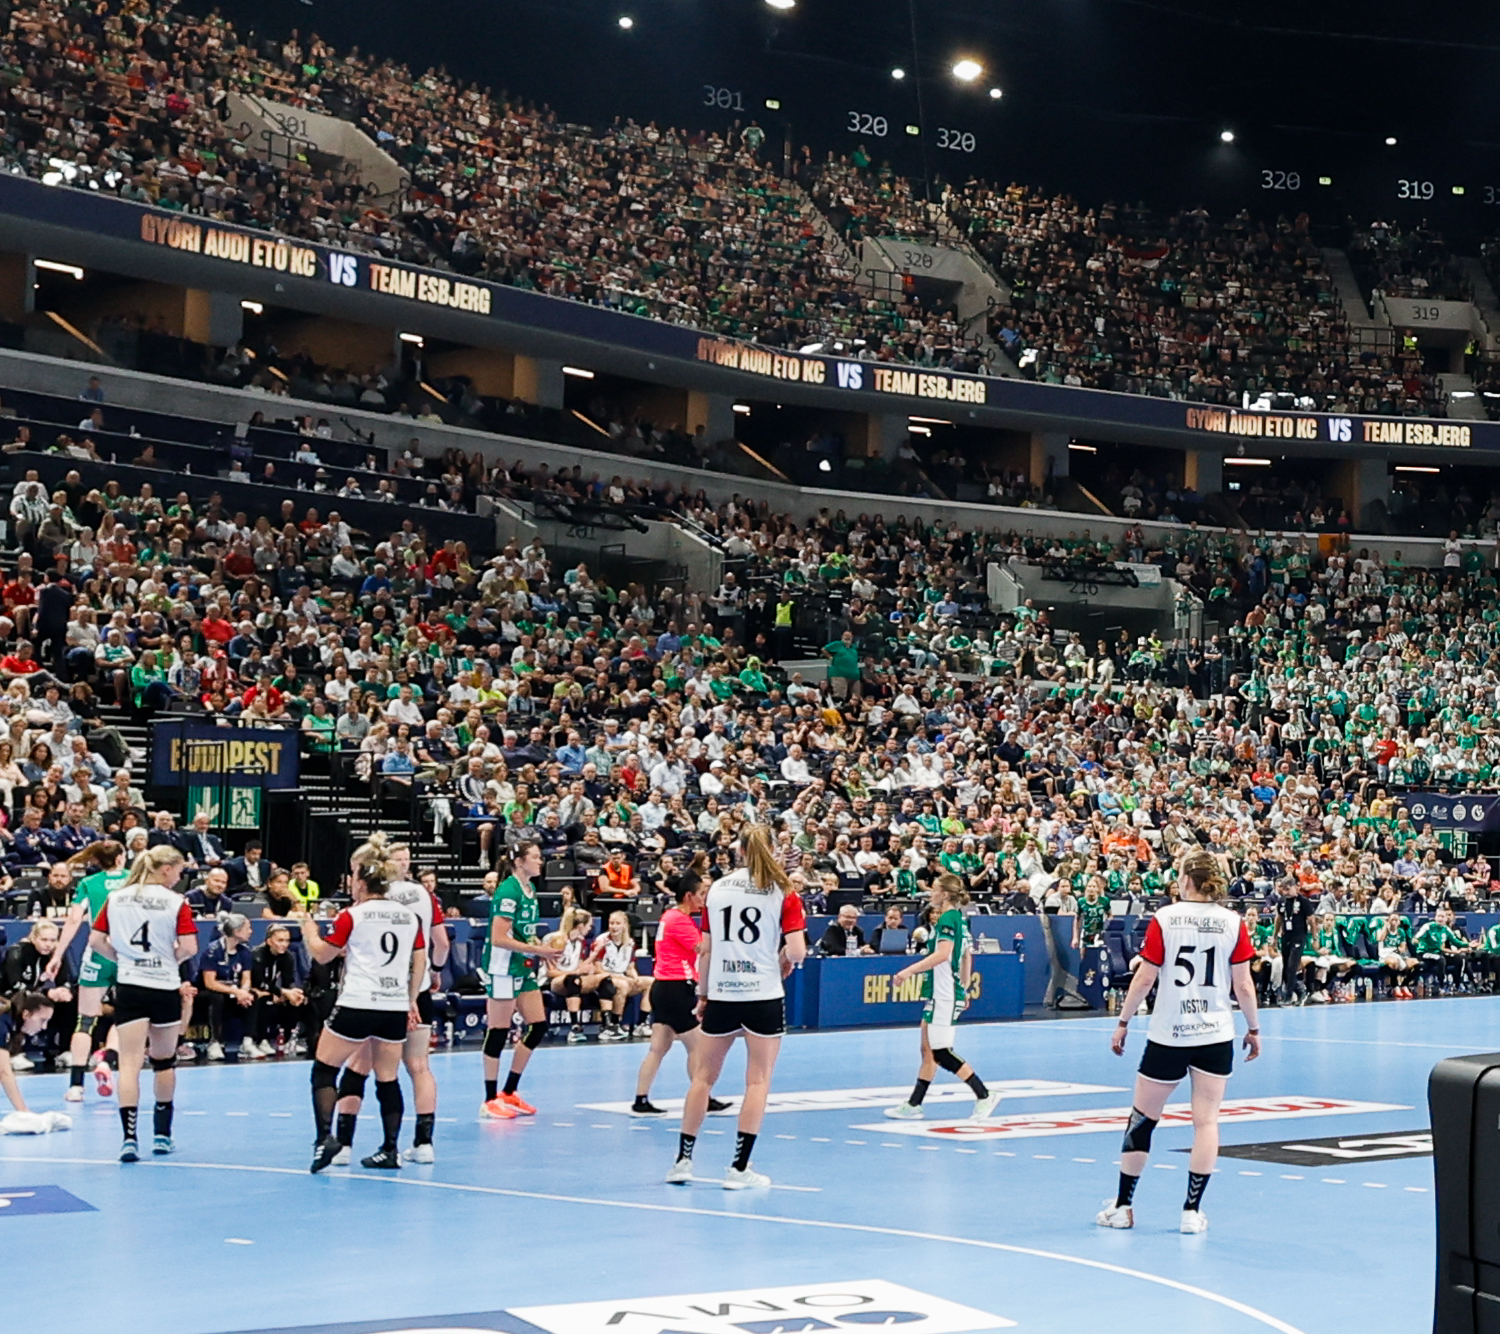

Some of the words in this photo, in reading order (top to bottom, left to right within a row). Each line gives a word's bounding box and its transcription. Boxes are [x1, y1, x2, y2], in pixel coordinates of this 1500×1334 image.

[703, 85, 744, 111] 301
[848, 111, 888, 137] 320
[937, 128, 976, 152] 320
[1261, 170, 1300, 190] 320
[1397, 179, 1434, 200] 319
[204, 228, 250, 263] AUDI
[252, 239, 288, 271] ETO
[290, 247, 316, 277] KC
[329, 253, 357, 287] VS
[369, 263, 416, 298] TEAM
[418, 274, 491, 314] ESBJERG
[904, 251, 932, 269] 320
[1412, 305, 1440, 320] 319
[740, 348, 772, 376] AUDI
[773, 354, 799, 380] ETO
[802, 360, 825, 383] KC
[837, 362, 862, 389] VS
[874, 369, 915, 395] TEAM
[918, 374, 985, 404] ESBJERG
[1229, 414, 1262, 436] AUDI
[1265, 417, 1294, 438] ETO
[1296, 418, 1317, 439] KC
[1329, 419, 1352, 442] VS
[1363, 421, 1403, 444] TEAM
[1405, 424, 1471, 446] ESBJERG
[129, 920, 150, 953] 4
[719, 905, 761, 945] 18
[380, 931, 399, 968] 9
[1174, 945, 1217, 987] 51
[863, 975, 890, 1003] EHF
